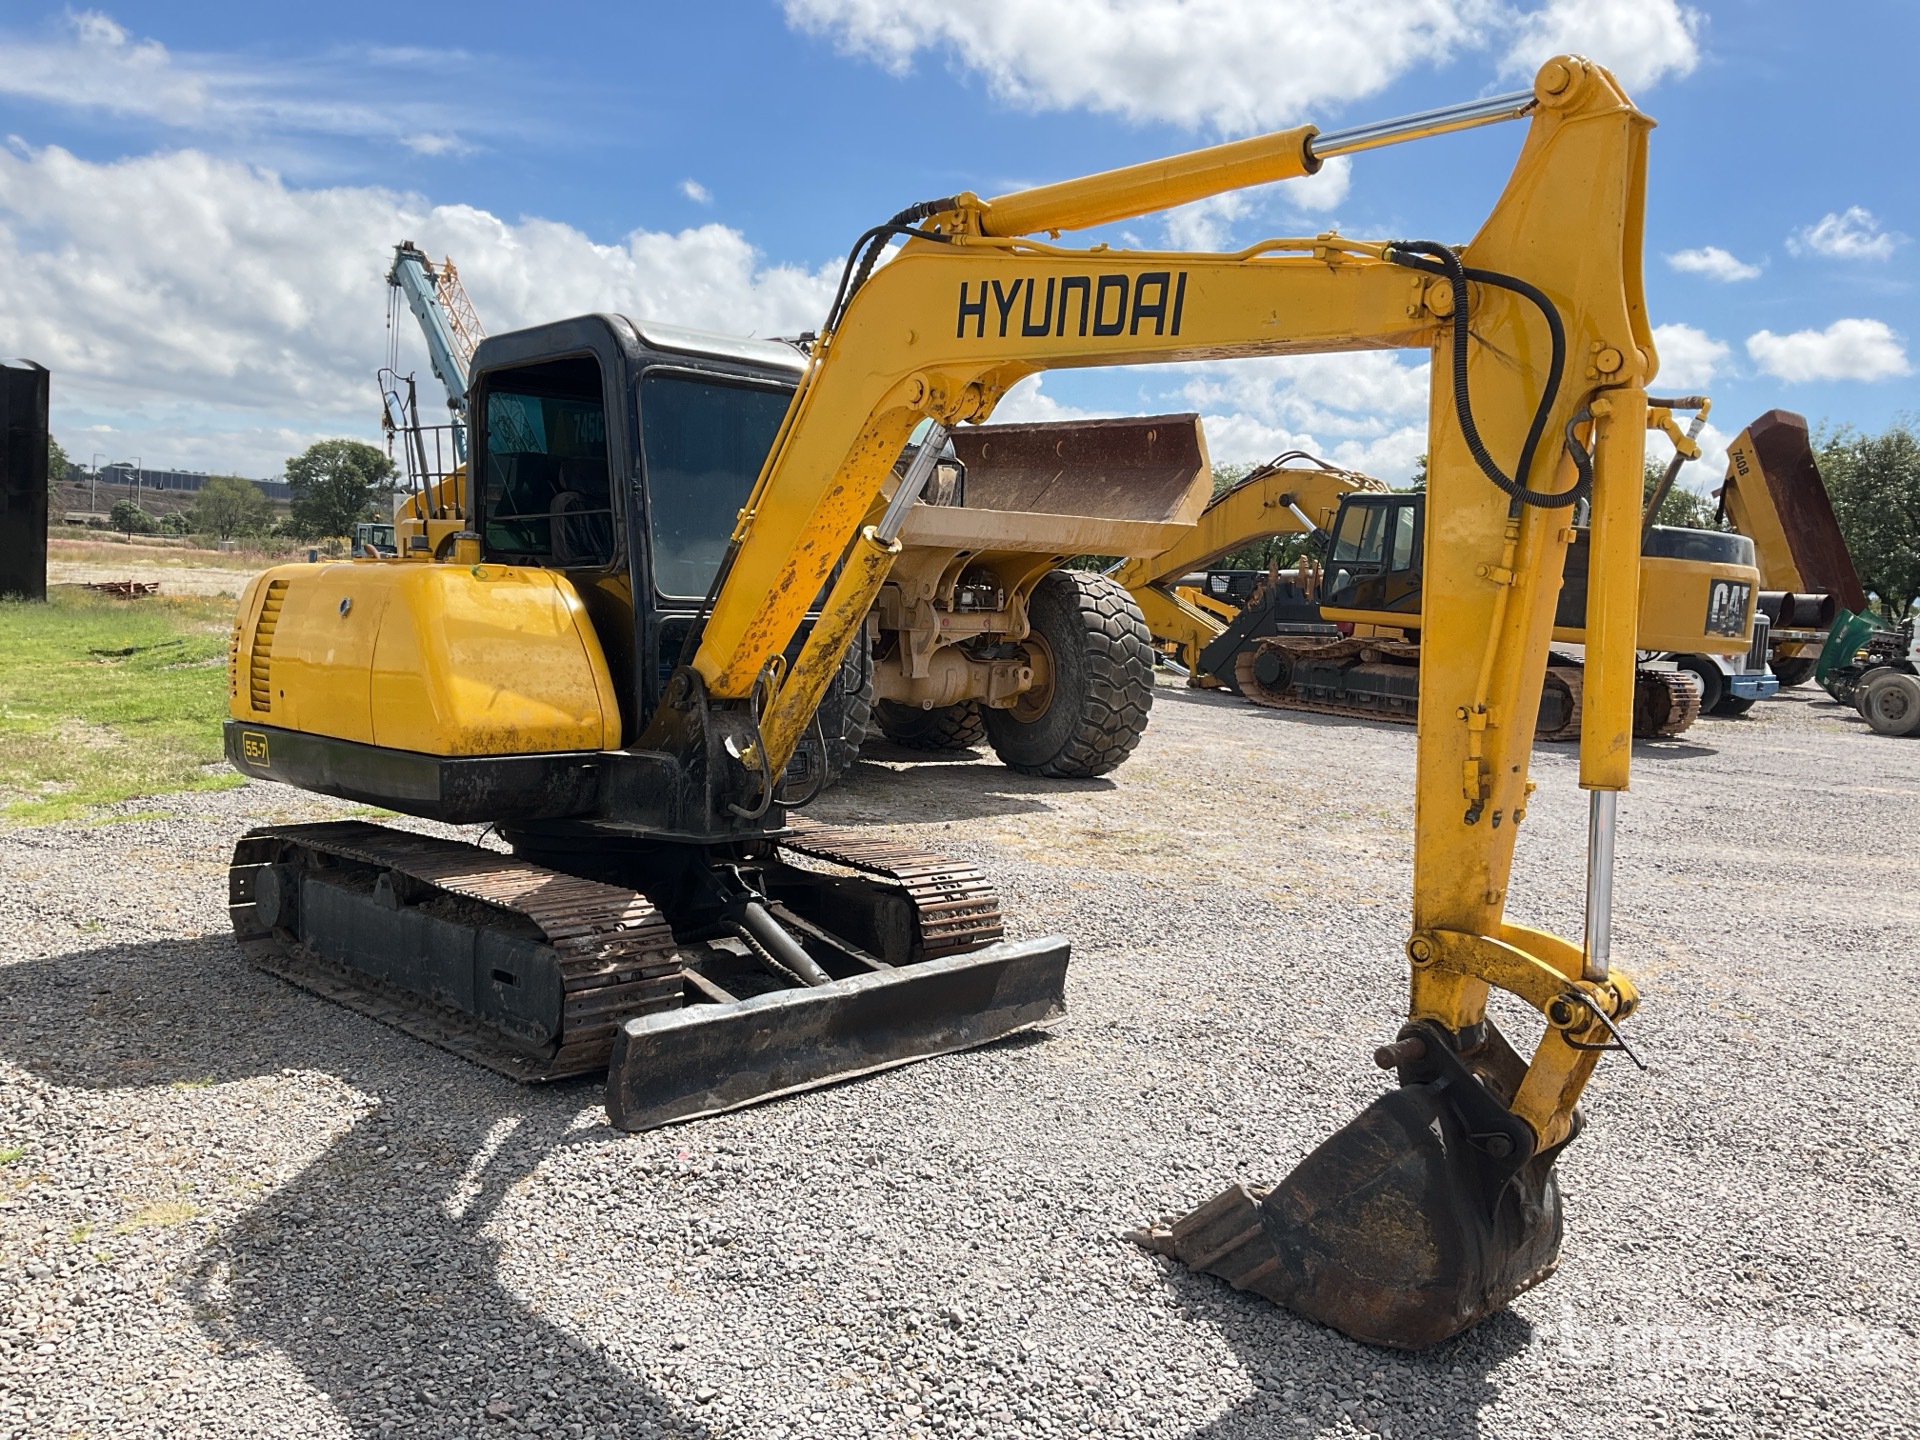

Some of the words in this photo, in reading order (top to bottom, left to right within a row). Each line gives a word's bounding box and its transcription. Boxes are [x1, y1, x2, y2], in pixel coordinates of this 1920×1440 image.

[956, 271, 1188, 338] HYUNDAI
[1731, 448, 1750, 476] 740B
[245, 740, 266, 758] 55-7
